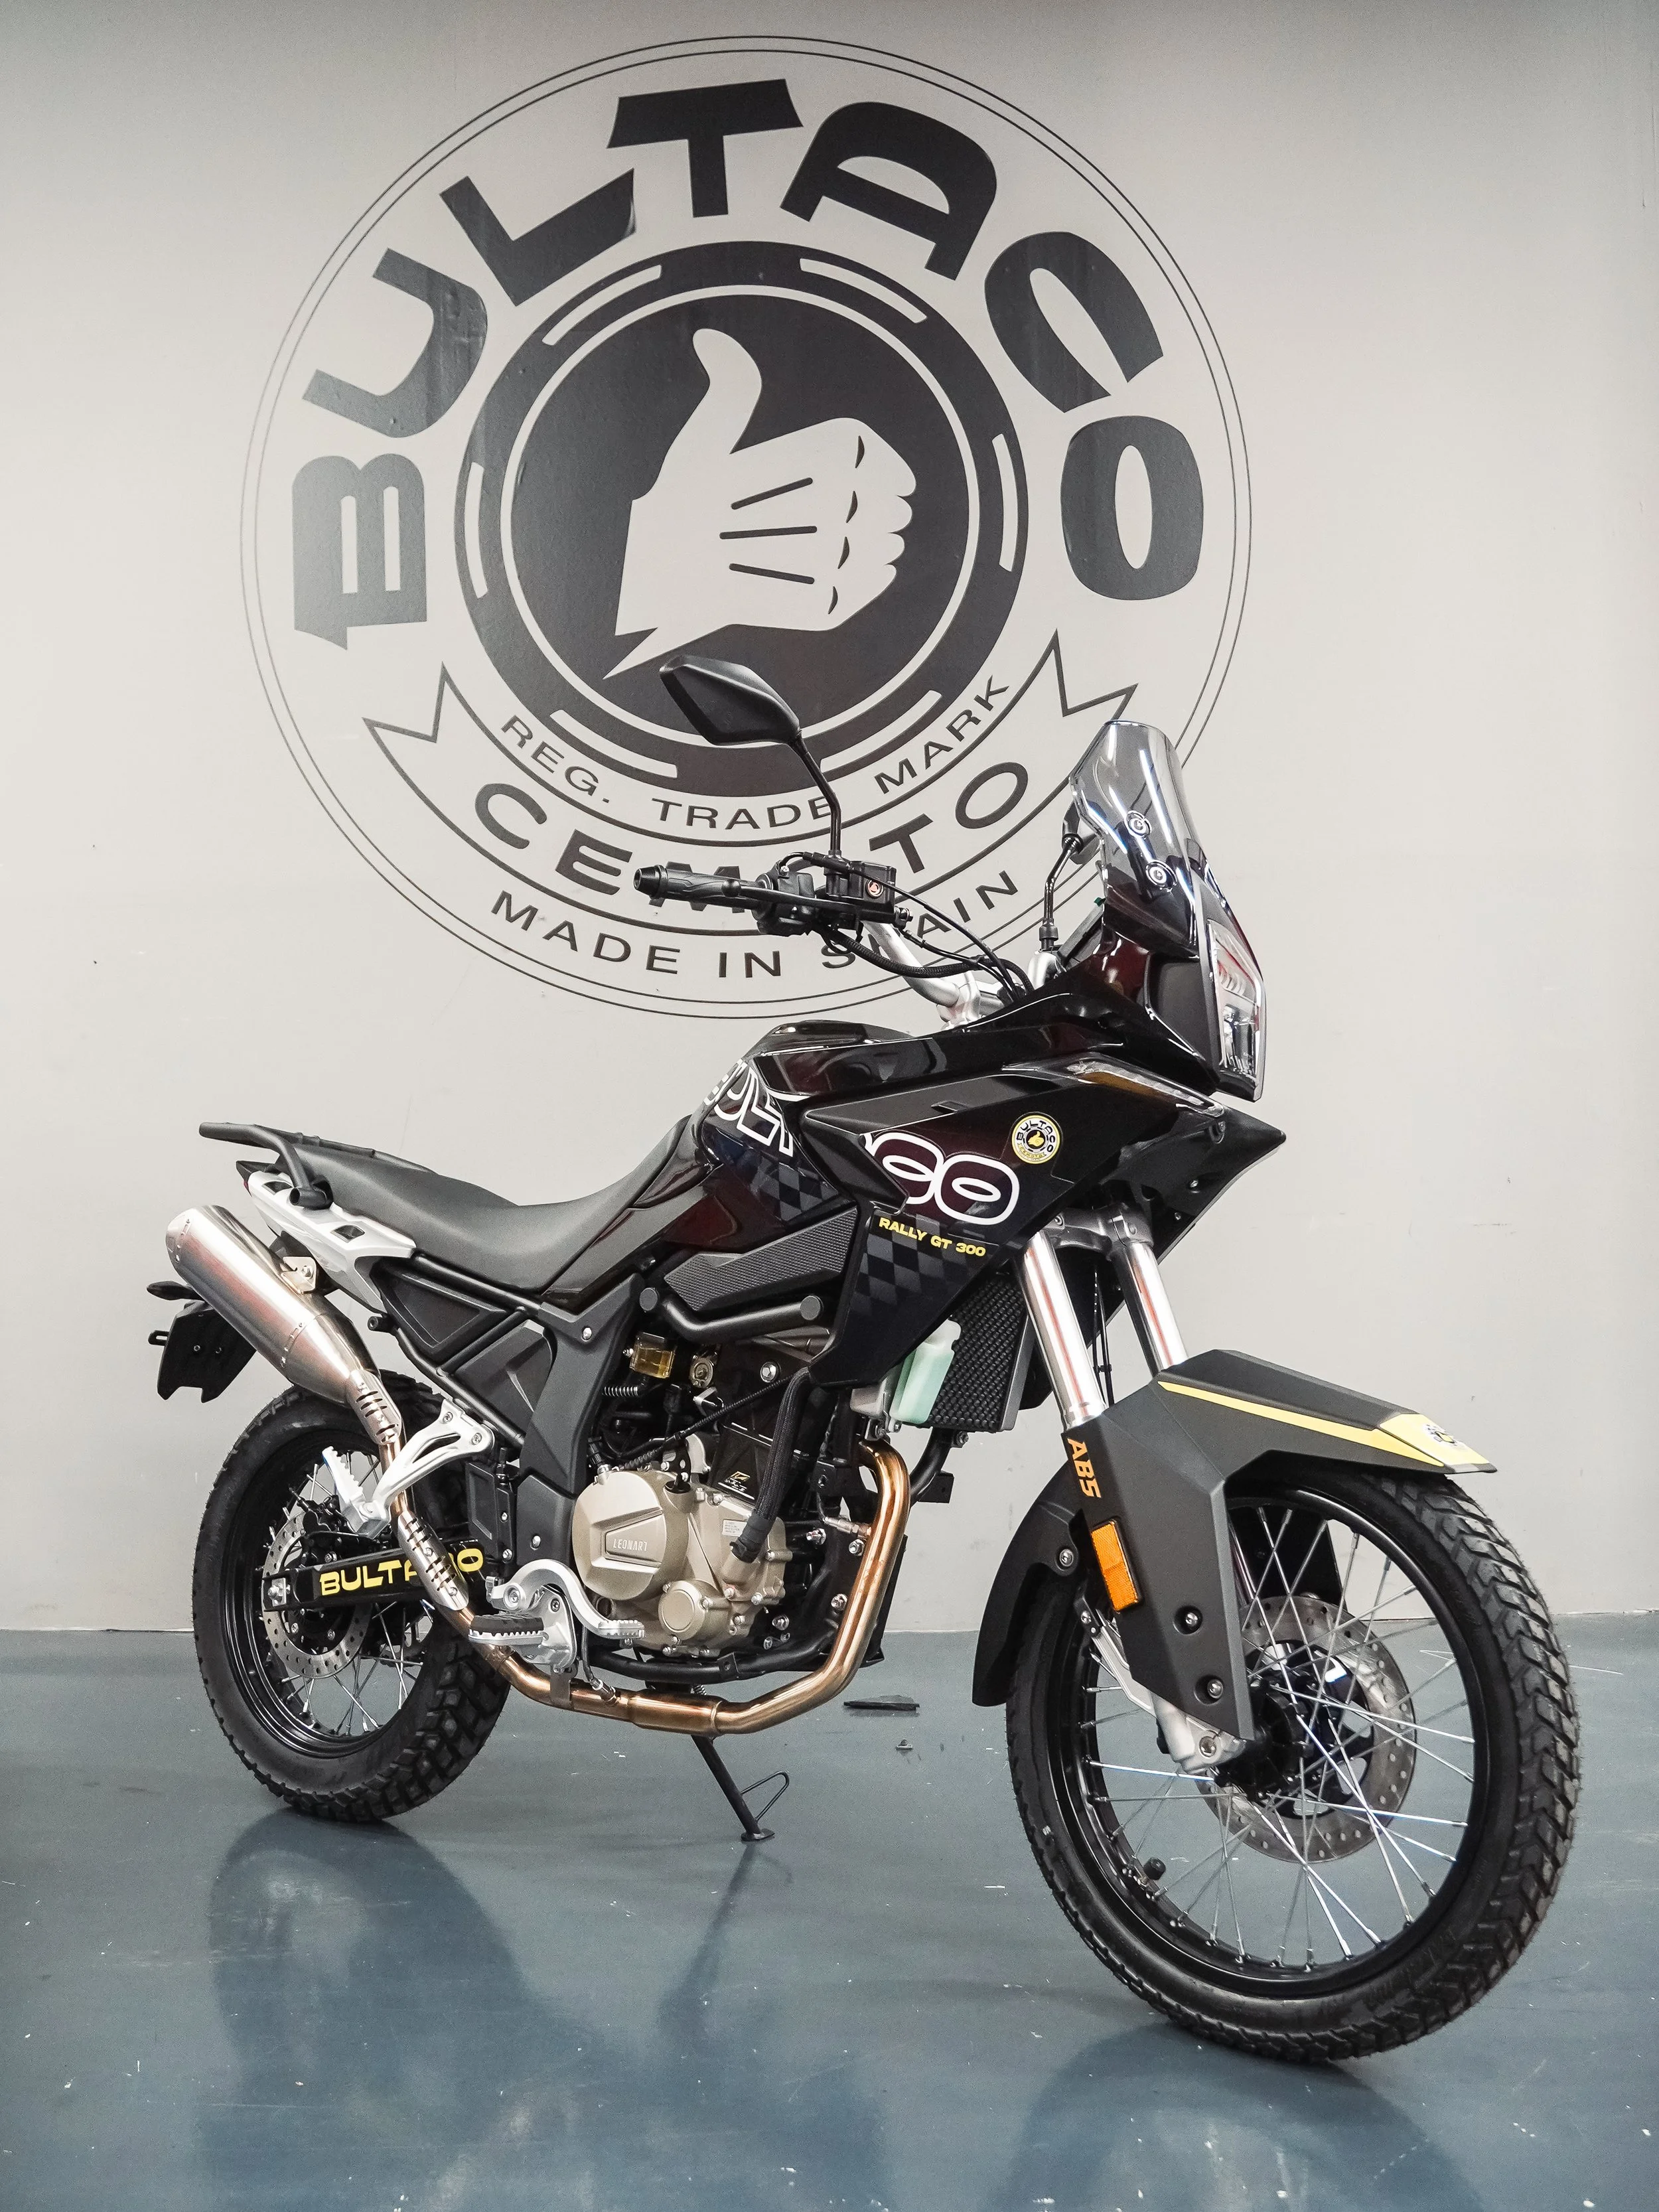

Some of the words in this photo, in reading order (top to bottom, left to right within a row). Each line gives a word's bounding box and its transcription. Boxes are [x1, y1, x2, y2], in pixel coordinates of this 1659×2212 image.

[292, 78, 1203, 650] BULTACO
[501, 714, 610, 804] REG.
[651, 796, 831, 830] TRADE
[874, 674, 1009, 794] MARK
[475, 761, 1029, 913] CETO
[490, 890, 681, 974] MADE
[718, 950, 782, 978] IN
[821, 870, 1019, 968] SAIN
[1016, 1120, 1056, 1153] BULTACO
[879, 1217, 928, 1241] RALLY
[930, 1235, 952, 1249] GT
[956, 1242, 986, 1257] 300
[1067, 1438, 1102, 1498] ABS
[319, 1548, 484, 1596] BULTO
[613, 1539, 648, 1552] LEONART
